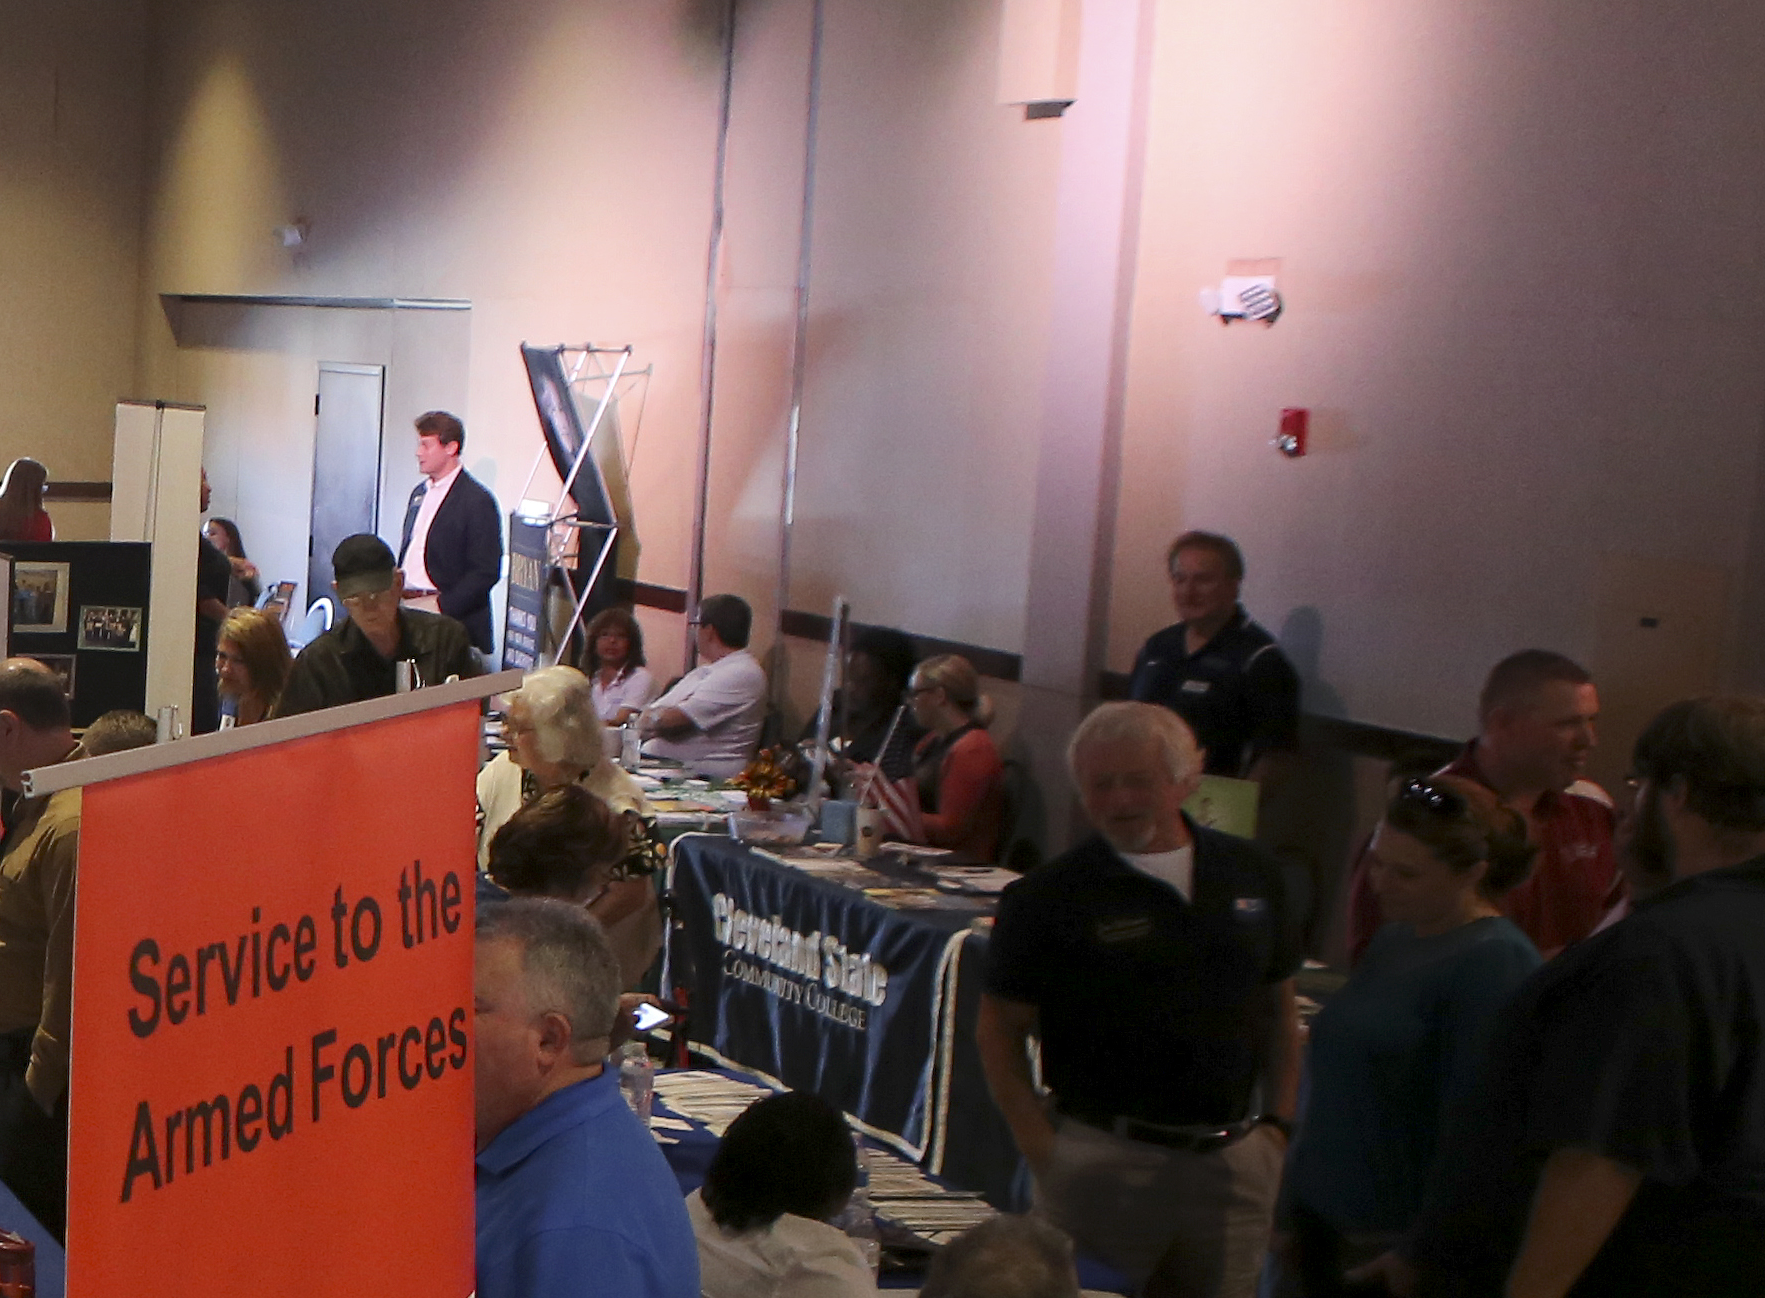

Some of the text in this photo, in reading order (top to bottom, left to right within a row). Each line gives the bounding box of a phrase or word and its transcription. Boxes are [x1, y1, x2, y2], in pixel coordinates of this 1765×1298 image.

[127, 859, 462, 1039] Service to the
[712, 892, 888, 1007] Cleveland State
[806, 982, 867, 1031] COLLEGE
[120, 1006, 468, 1203] Armed Forces
